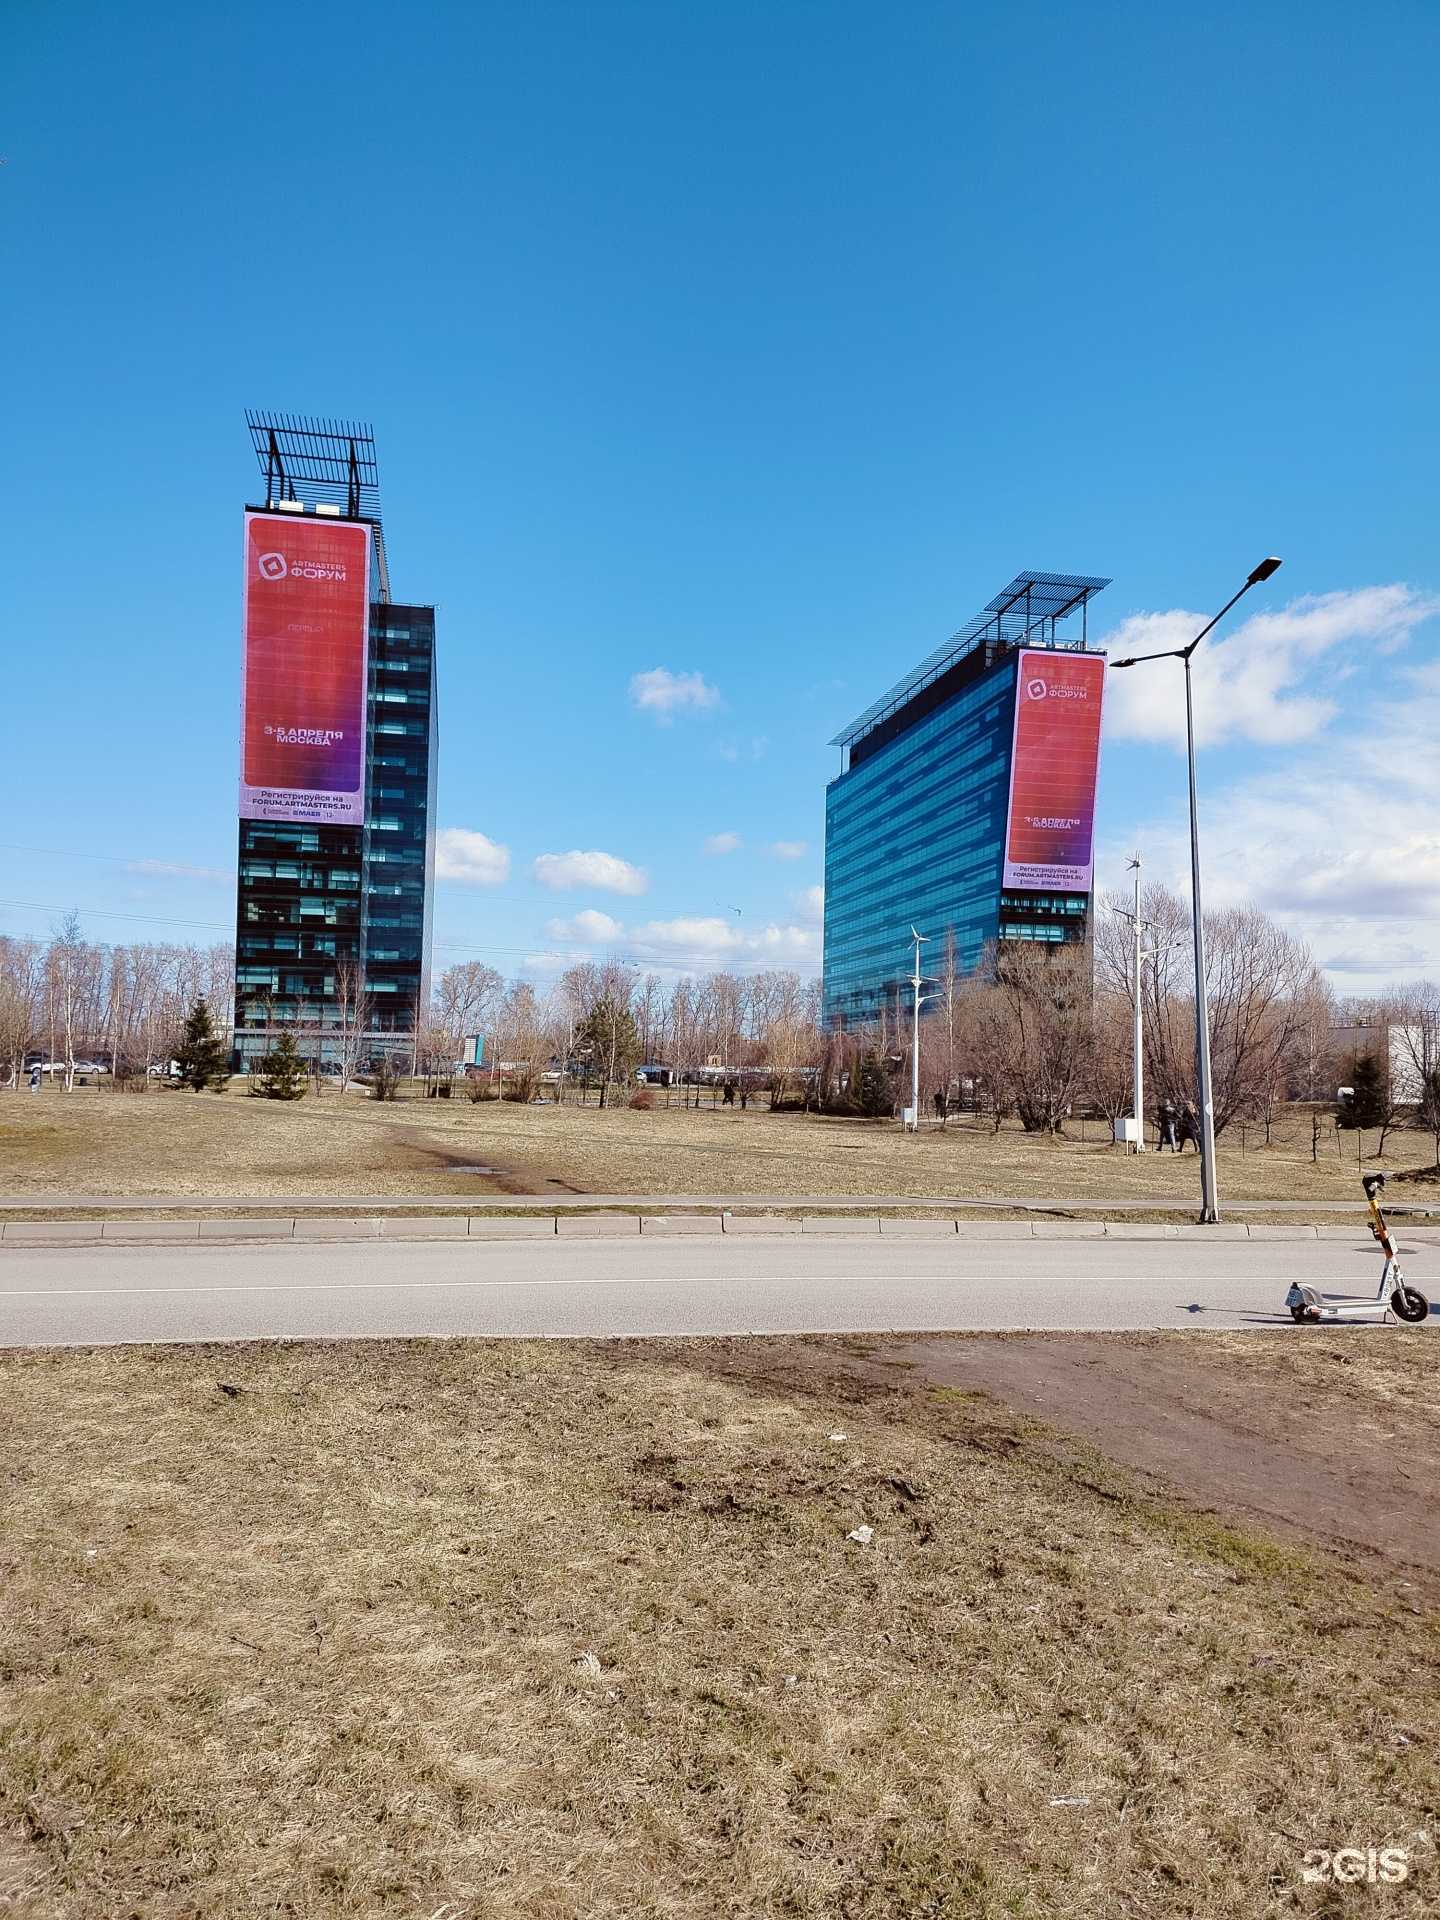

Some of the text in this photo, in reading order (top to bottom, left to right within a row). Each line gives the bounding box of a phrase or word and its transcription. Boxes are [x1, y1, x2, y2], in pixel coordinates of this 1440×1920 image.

[291, 567, 346, 581] ФОРУМ
[1049, 690, 1087, 699] ФОРУМ
[276, 734, 331, 746] МОСКВА
[287, 728, 343, 740] АПРЕЛЯ
[261, 790, 330, 802] Регистрируйся
[252, 798, 352, 811] FORUM.ARTMASTERS.RU
